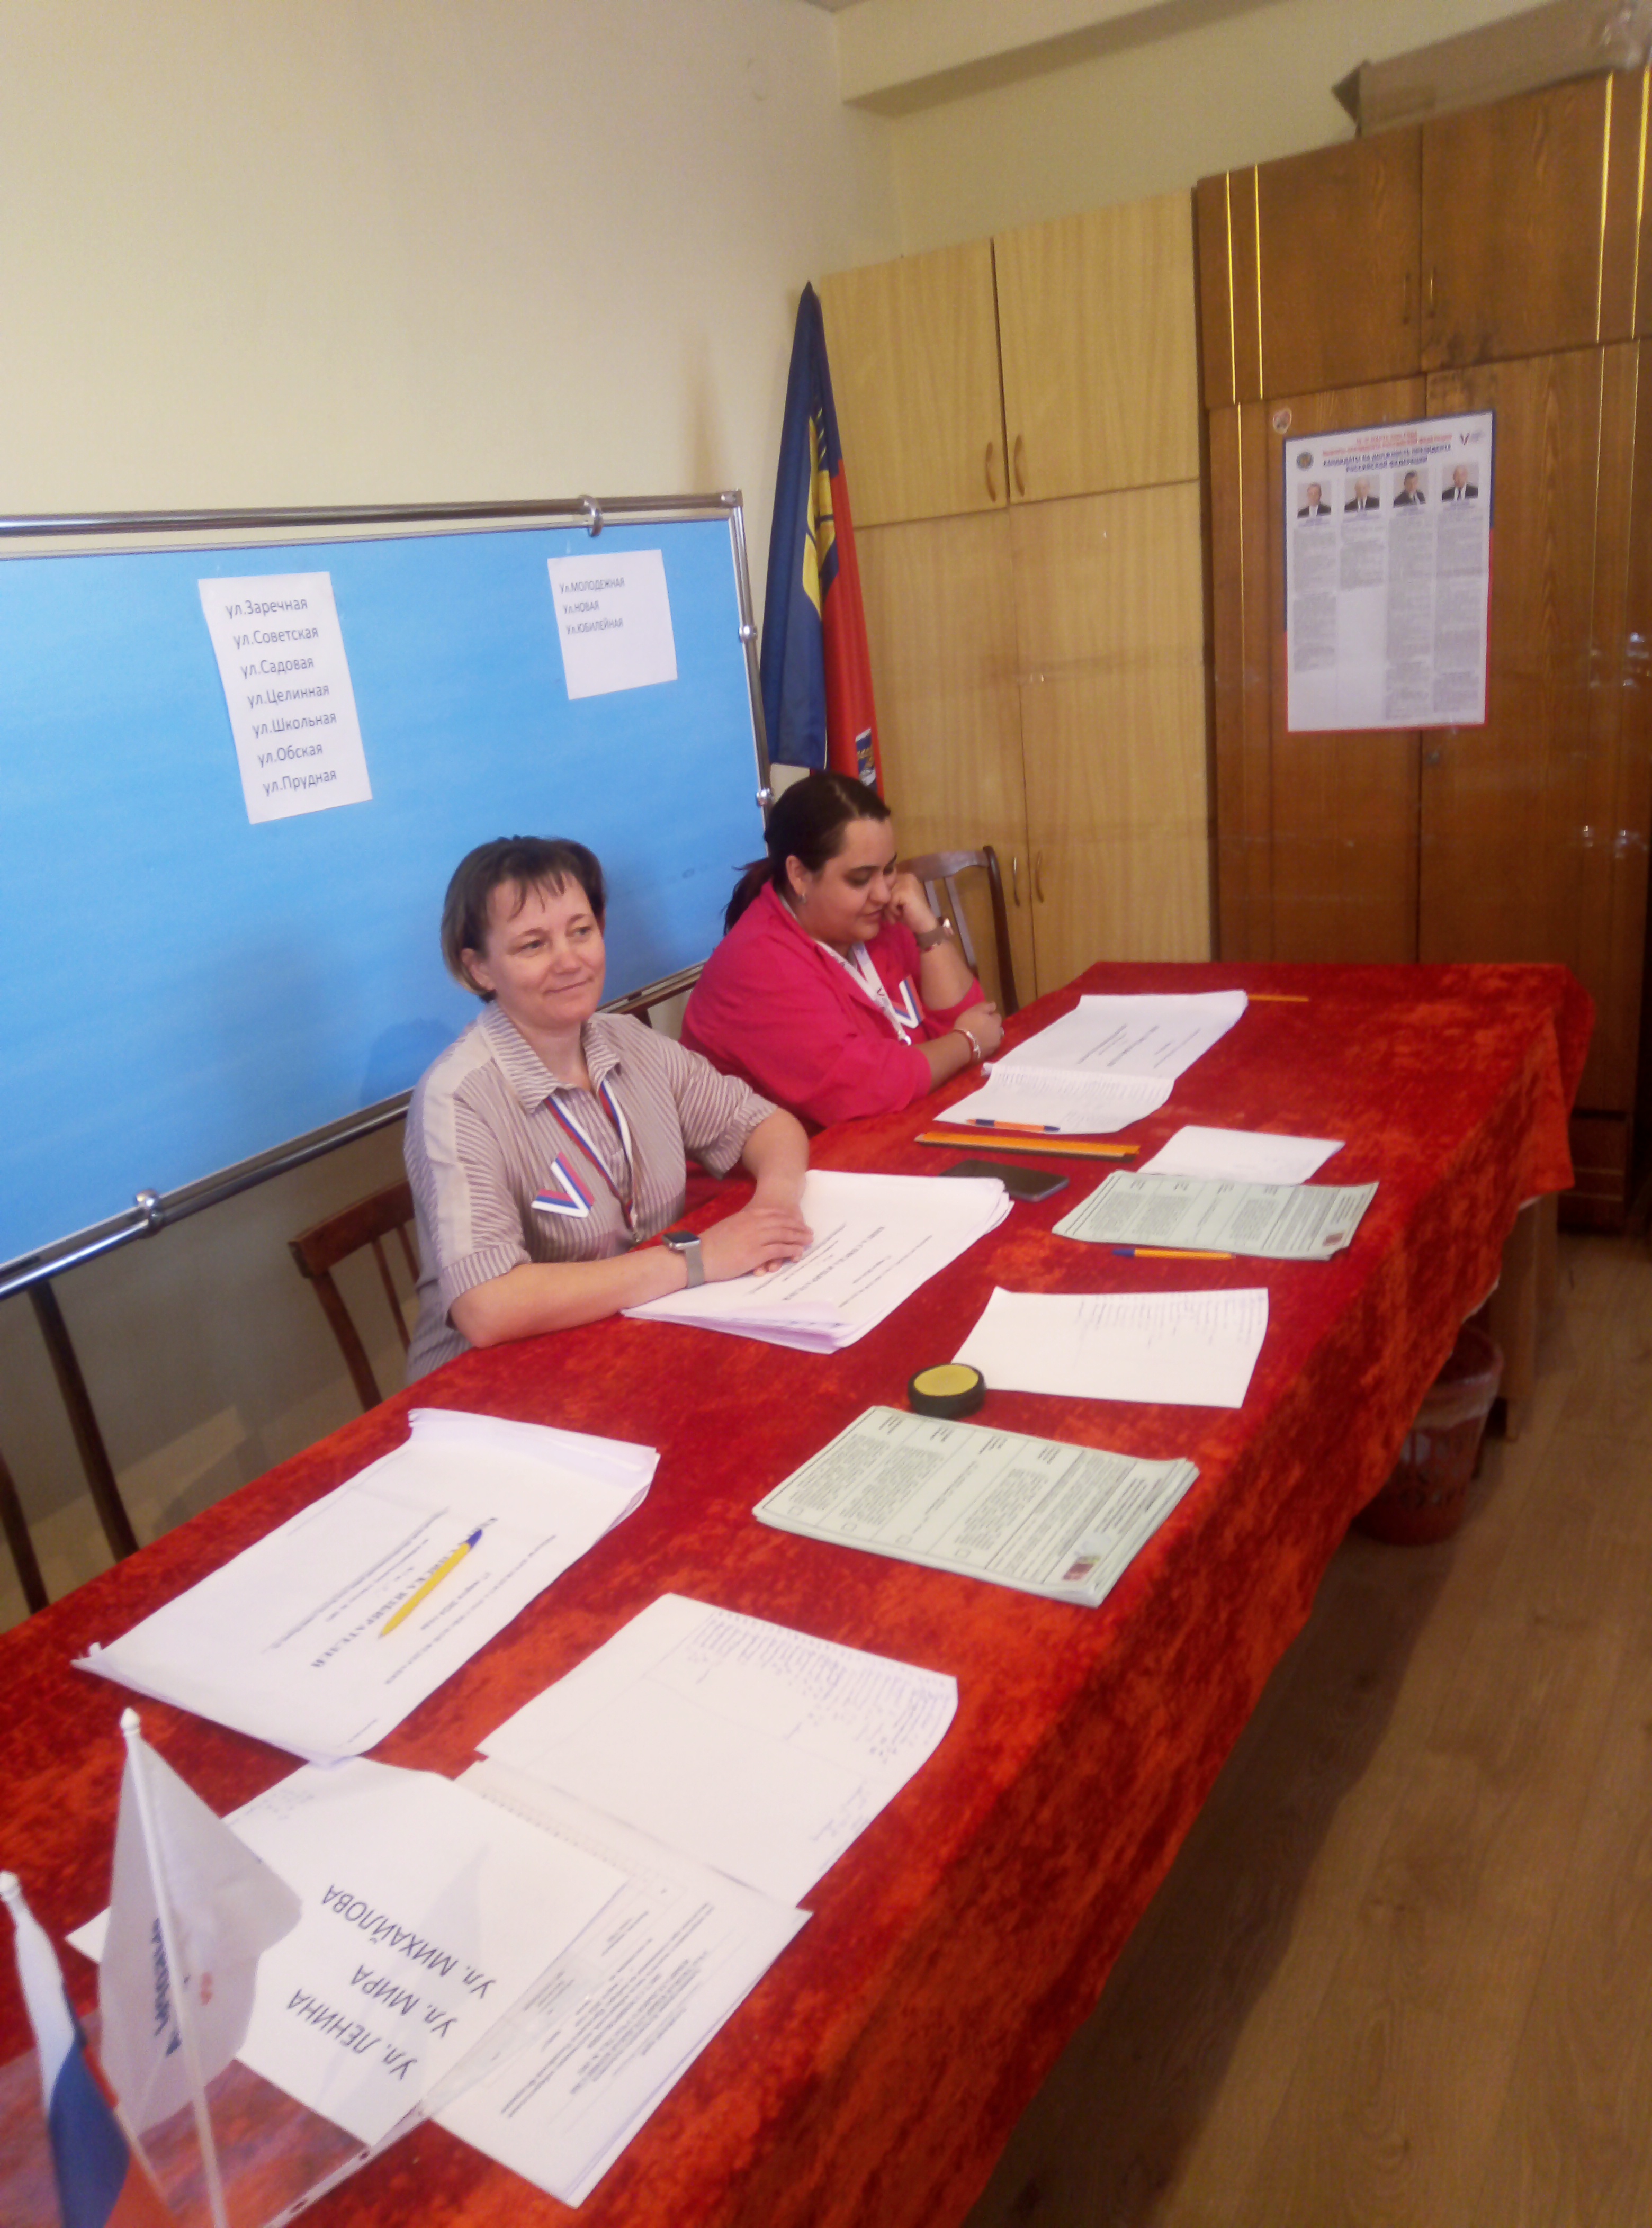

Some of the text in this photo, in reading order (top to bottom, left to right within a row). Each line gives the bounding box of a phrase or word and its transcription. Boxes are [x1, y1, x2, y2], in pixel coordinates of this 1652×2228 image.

[225, 599, 308, 618] ул.Заречная
[234, 626, 319, 649] ул.Советская
[240, 656, 315, 679] ул.Садовая
[247, 684, 330, 708] ул.Целинная
[252, 713, 337, 738] ул.Школьная
[257, 743, 323, 767] ул.Обская
[263, 769, 337, 796] ул.Прудная
[321, 1884, 459, 1978] МИХАЙЛОВА
[350, 1964, 421, 2016] МИРА
[286, 1988, 383, 2054] ЛЕНИНА
